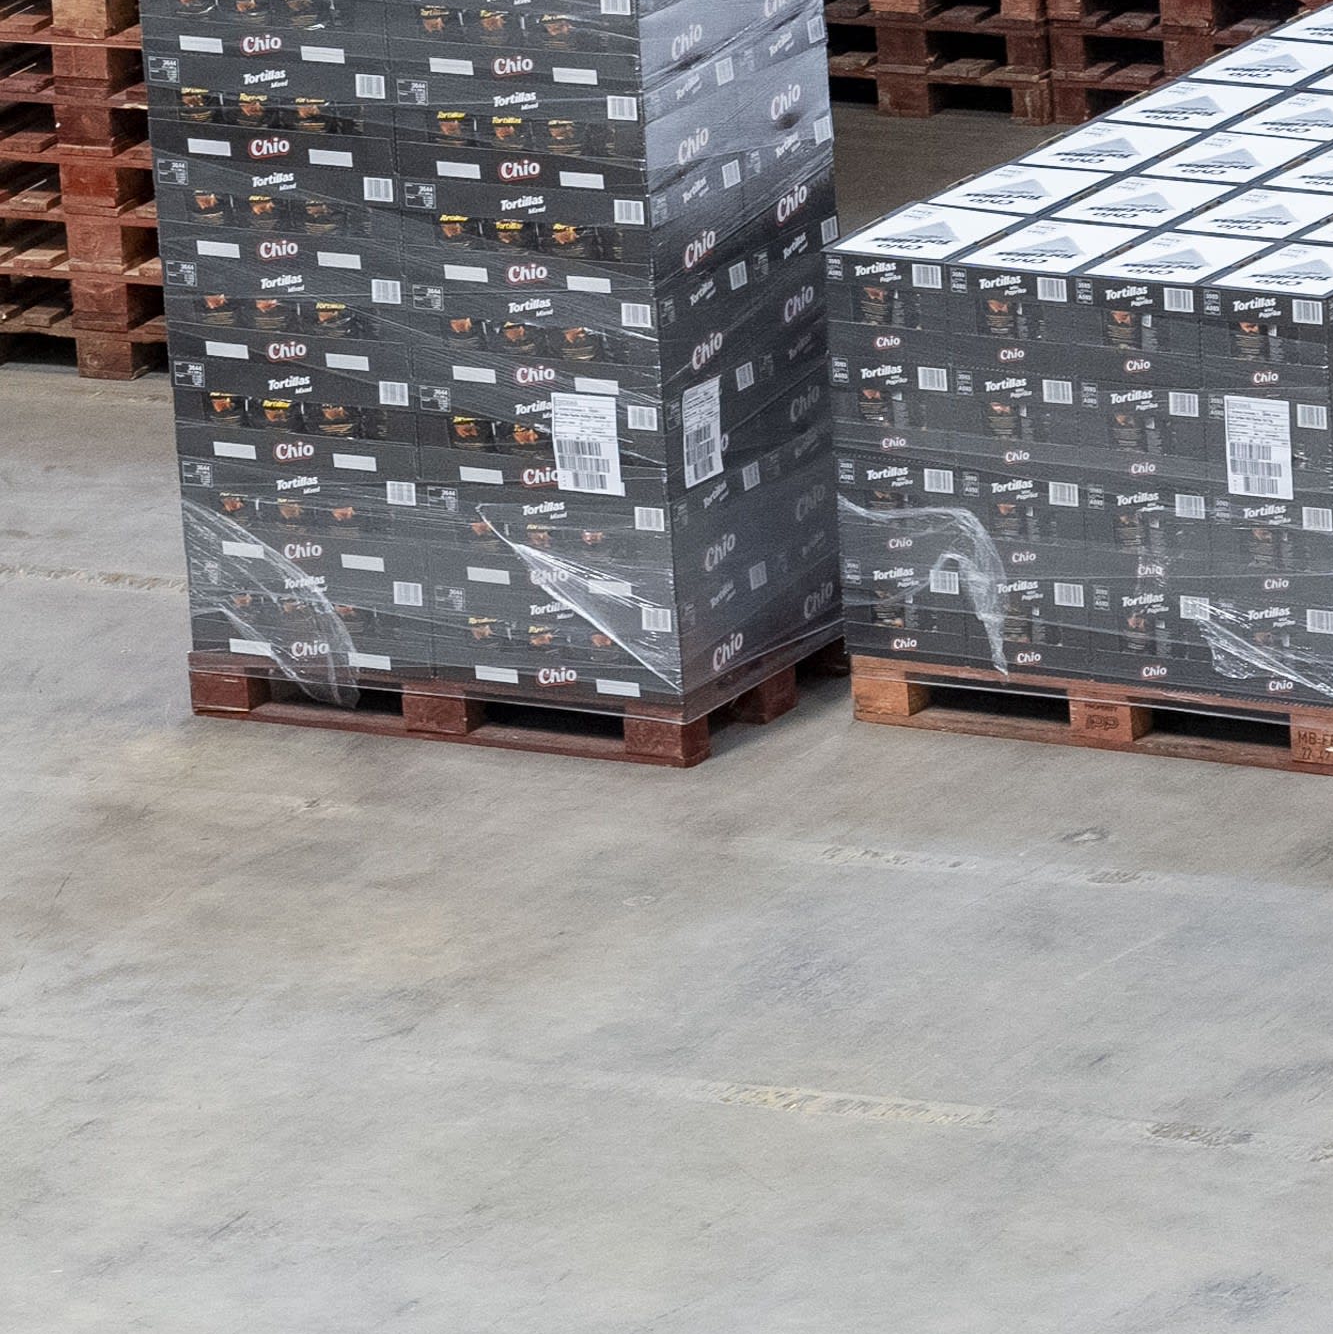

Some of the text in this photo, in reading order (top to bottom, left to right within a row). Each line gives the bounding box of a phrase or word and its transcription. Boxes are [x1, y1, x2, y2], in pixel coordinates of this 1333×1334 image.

[243, 35, 281, 53] Chio
[494, 56, 533, 74] Chio
[243, 69, 286, 84] Tortillas
[493, 92, 536, 107] Tortillas
[251, 137, 290, 155] Chio
[500, 160, 540, 178] Chio
[252, 173, 294, 187] Tortillas
[500, 196, 544, 211] Tortillas
[777, 185, 807, 222] Chio
[259, 240, 298, 258] Chio
[685, 230, 716, 269] Chio
[508, 264, 547, 282] Chio
[855, 262, 896, 276] Tortillas
[260, 275, 302, 289] Tortillas
[979, 275, 1021, 289] Tortillas
[1105, 286, 1148, 300] Tortillas
[508, 299, 551, 313] Tortillas
[1233, 297, 1276, 311] Tortillas
[876, 336, 900, 348] Chio
[268, 342, 306, 360] Chio
[1000, 348, 1024, 360] Chio
[860, 365, 902, 379] Tortillas
[1126, 360, 1150, 371] Chio
[516, 367, 554, 383] Chio
[1254, 371, 1278, 383] Chio
[268, 376, 310, 391] Tortillas
[985, 377, 1027, 391] Tortillas
[1110, 390, 1153, 404] Tortillas
[882, 437, 906, 449] Chio
[275, 442, 314, 460] Chio
[1006, 451, 1030, 462] Chio
[866, 467, 908, 481] Tortillas
[1131, 463, 1156, 474] Chio
[992, 479, 1033, 493] Tortillas
[1116, 491, 1159, 505] Tortillas
[522, 501, 565, 515] Tortillas
[894, 639, 917, 649] Chio
[713, 632, 743, 671] Chio
[1017, 652, 1041, 663] Chio
[538, 667, 576, 684] Chio
[1143, 666, 1166, 677] Chio
